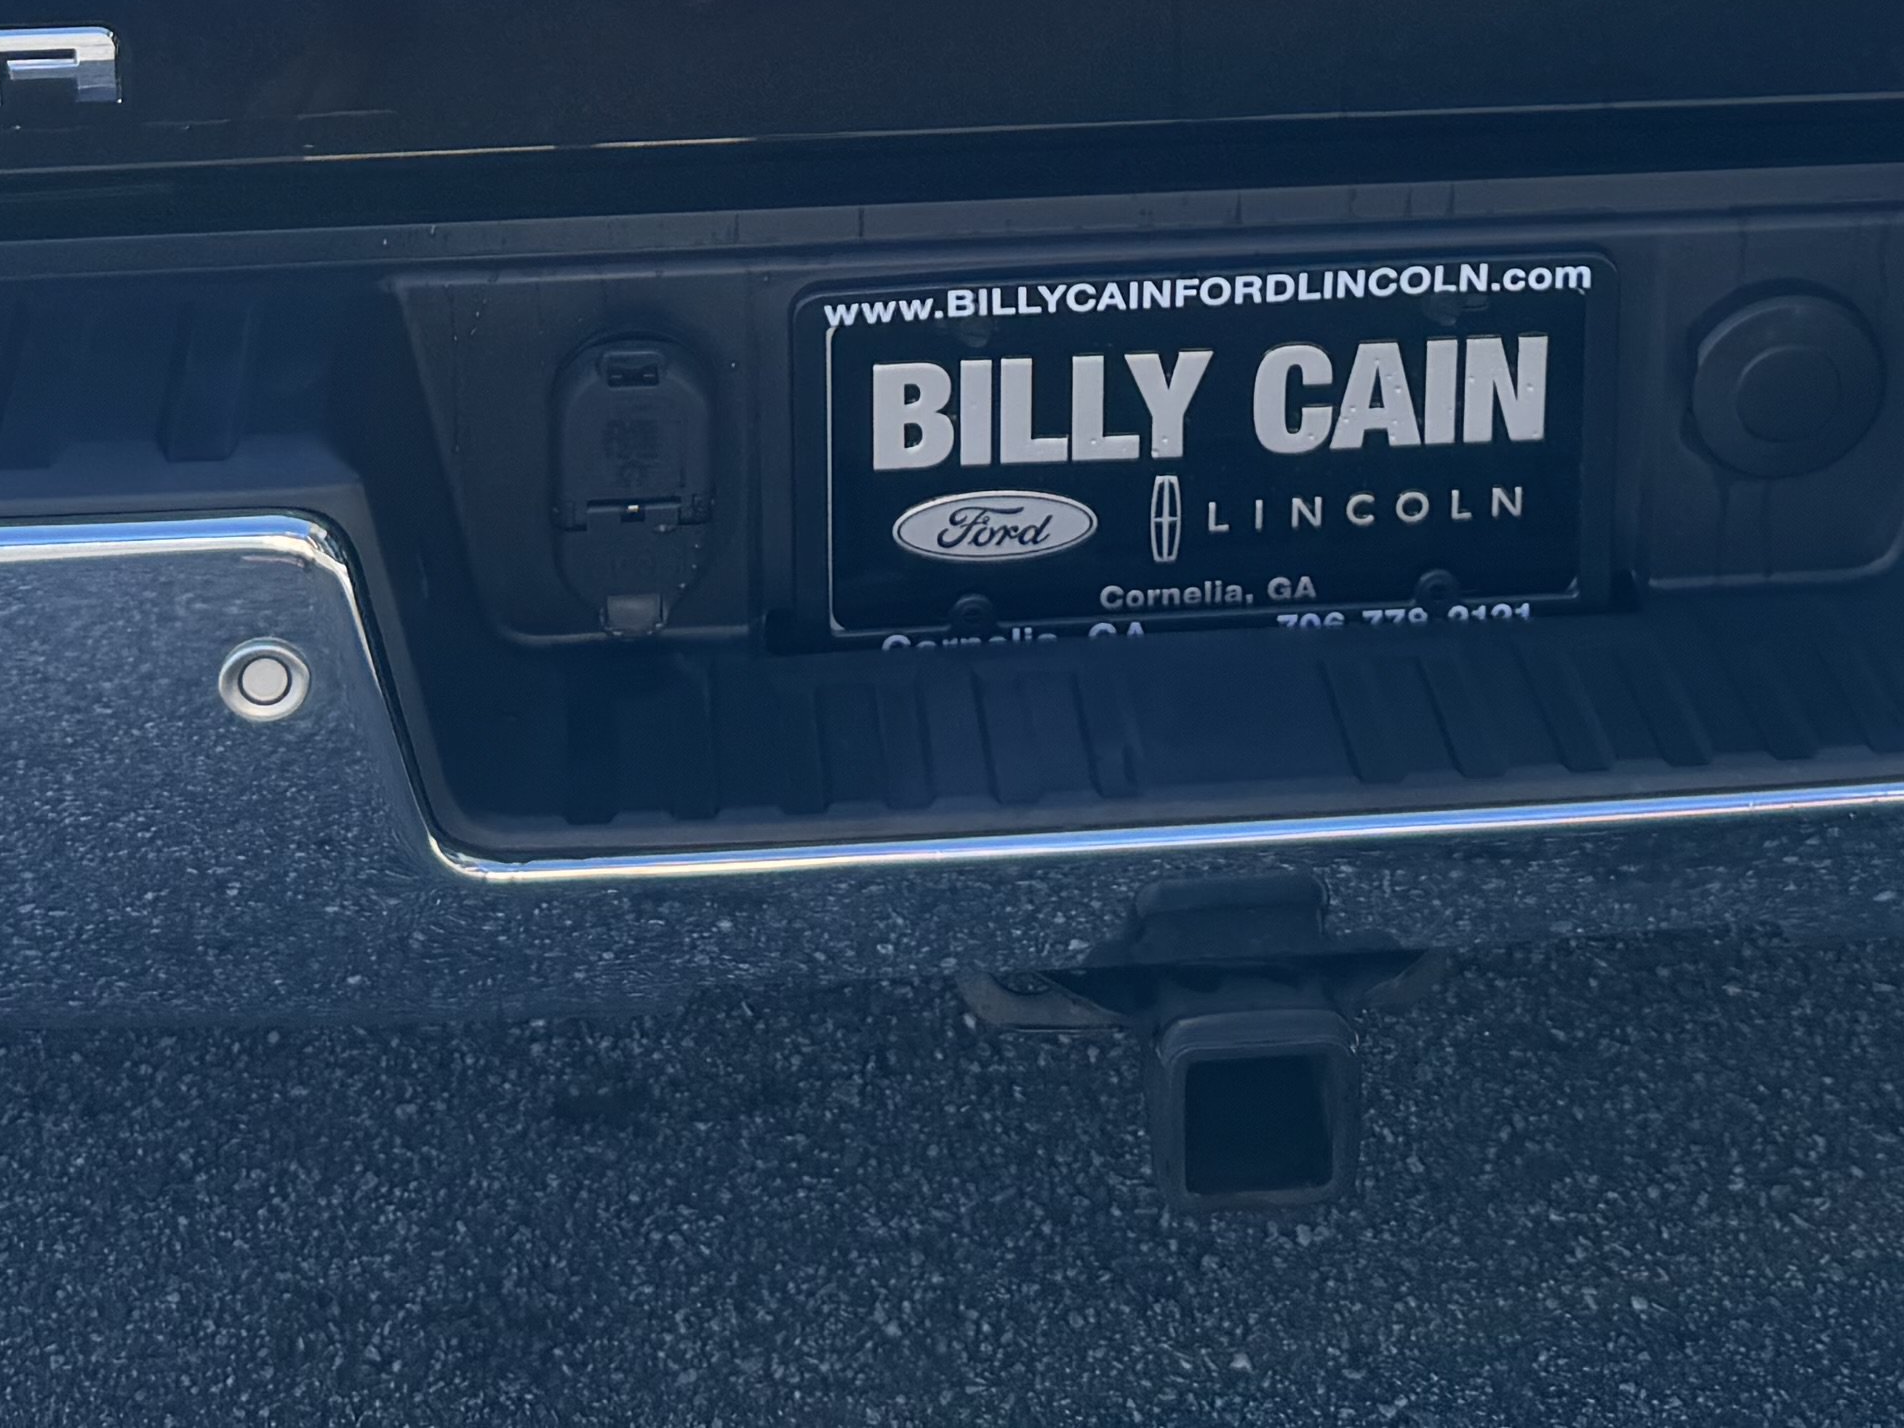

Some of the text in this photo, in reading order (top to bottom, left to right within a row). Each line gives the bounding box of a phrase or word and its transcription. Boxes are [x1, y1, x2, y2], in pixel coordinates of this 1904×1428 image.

[823, 262, 1592, 327] www.BILLYCAINFORDLINCOLN.com
[871, 331, 1550, 473] BILLY CAIN
[936, 485, 1524, 550] Ford LINCOLN
[1098, 574, 1318, 610] Cornelia, GA
